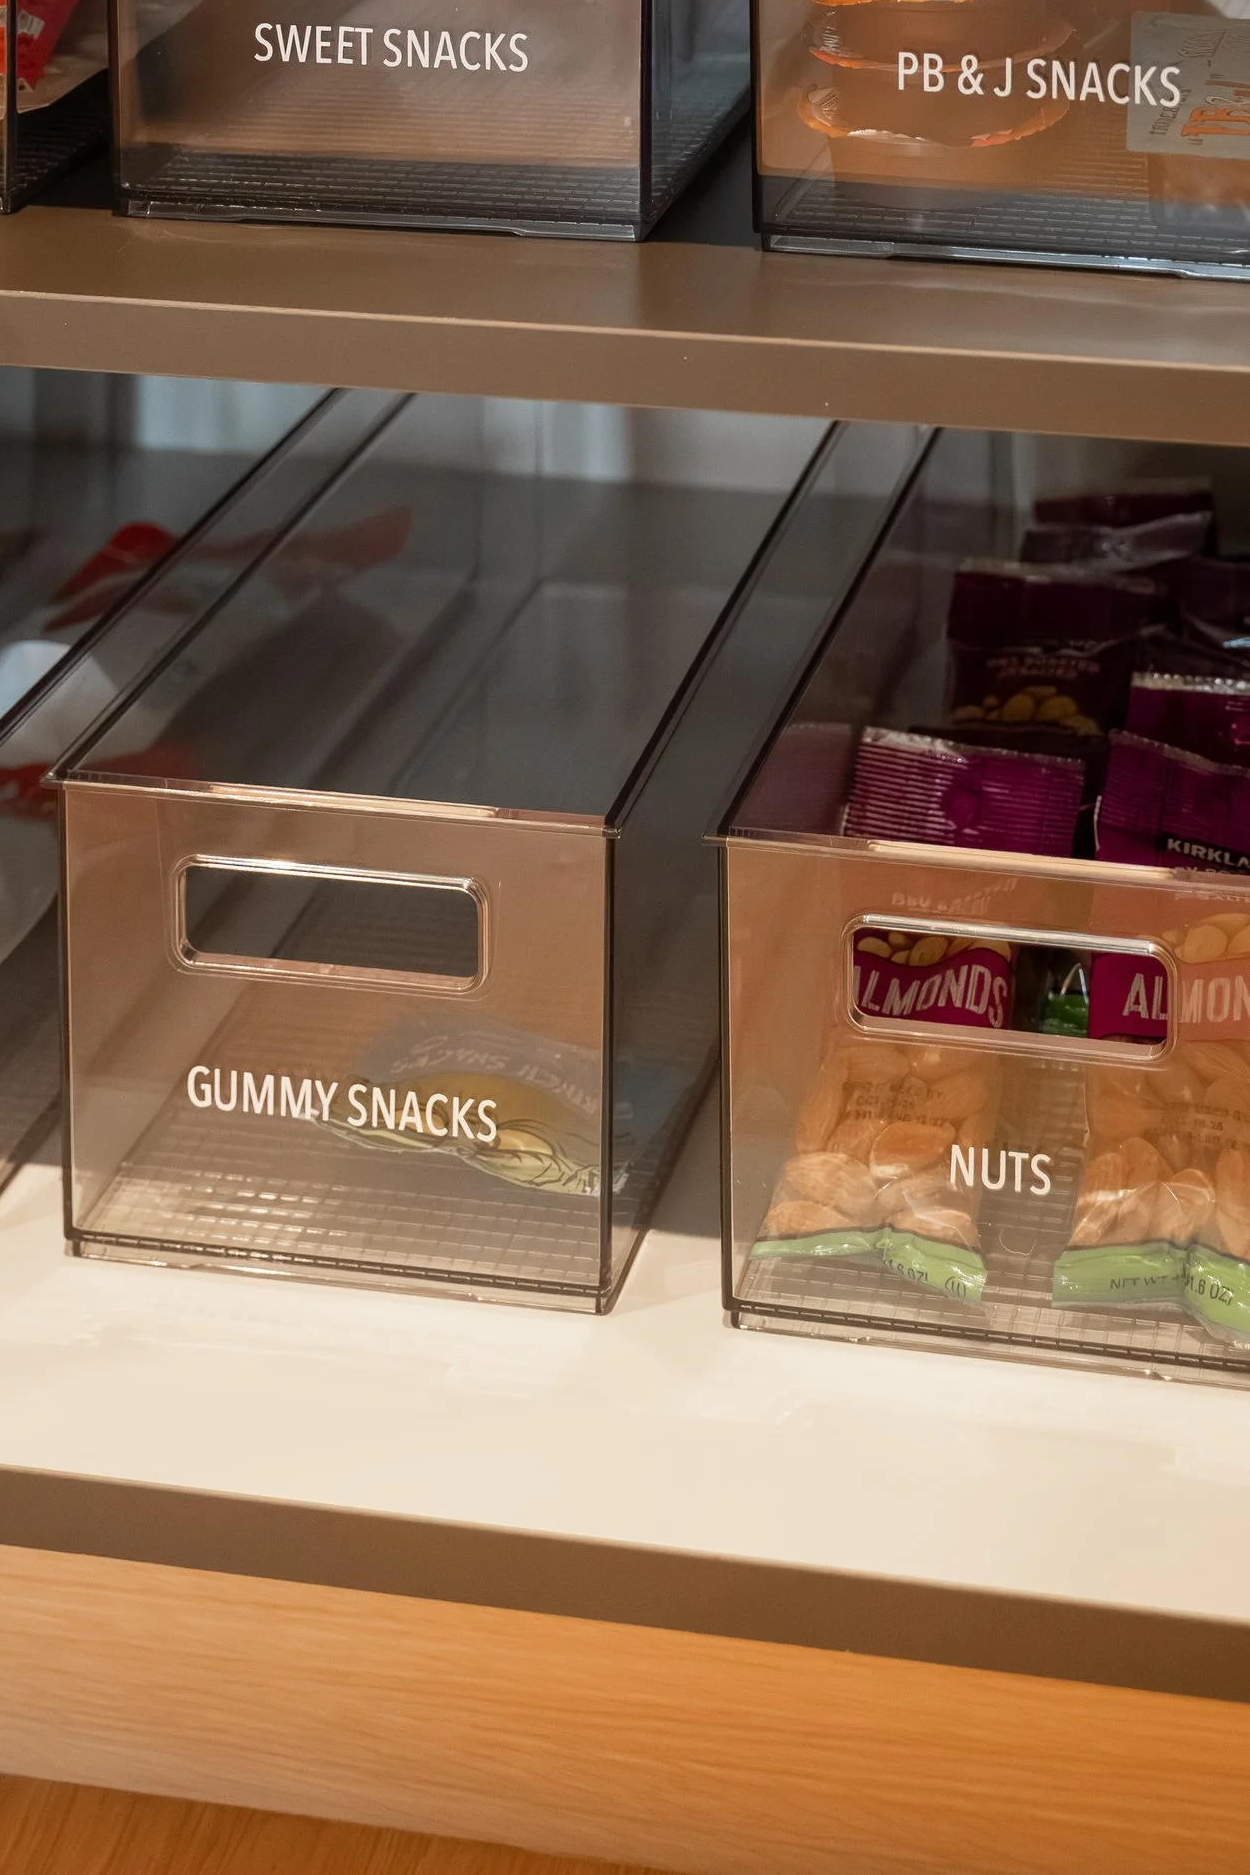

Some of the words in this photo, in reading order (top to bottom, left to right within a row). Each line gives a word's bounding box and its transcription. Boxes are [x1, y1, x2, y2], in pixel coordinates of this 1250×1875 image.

[253, 21, 374, 67] SWEET
[382, 28, 530, 74] SNACKS
[897, 51, 945, 94] PB
[957, 54, 985, 96] &
[993, 57, 1013, 98] J
[1026, 58, 1181, 109] SNACKS
[186, 1064, 336, 1121] GUMMY
[347, 1082, 498, 1143] SNACKS
[949, 1143, 1052, 1196] NUTS
